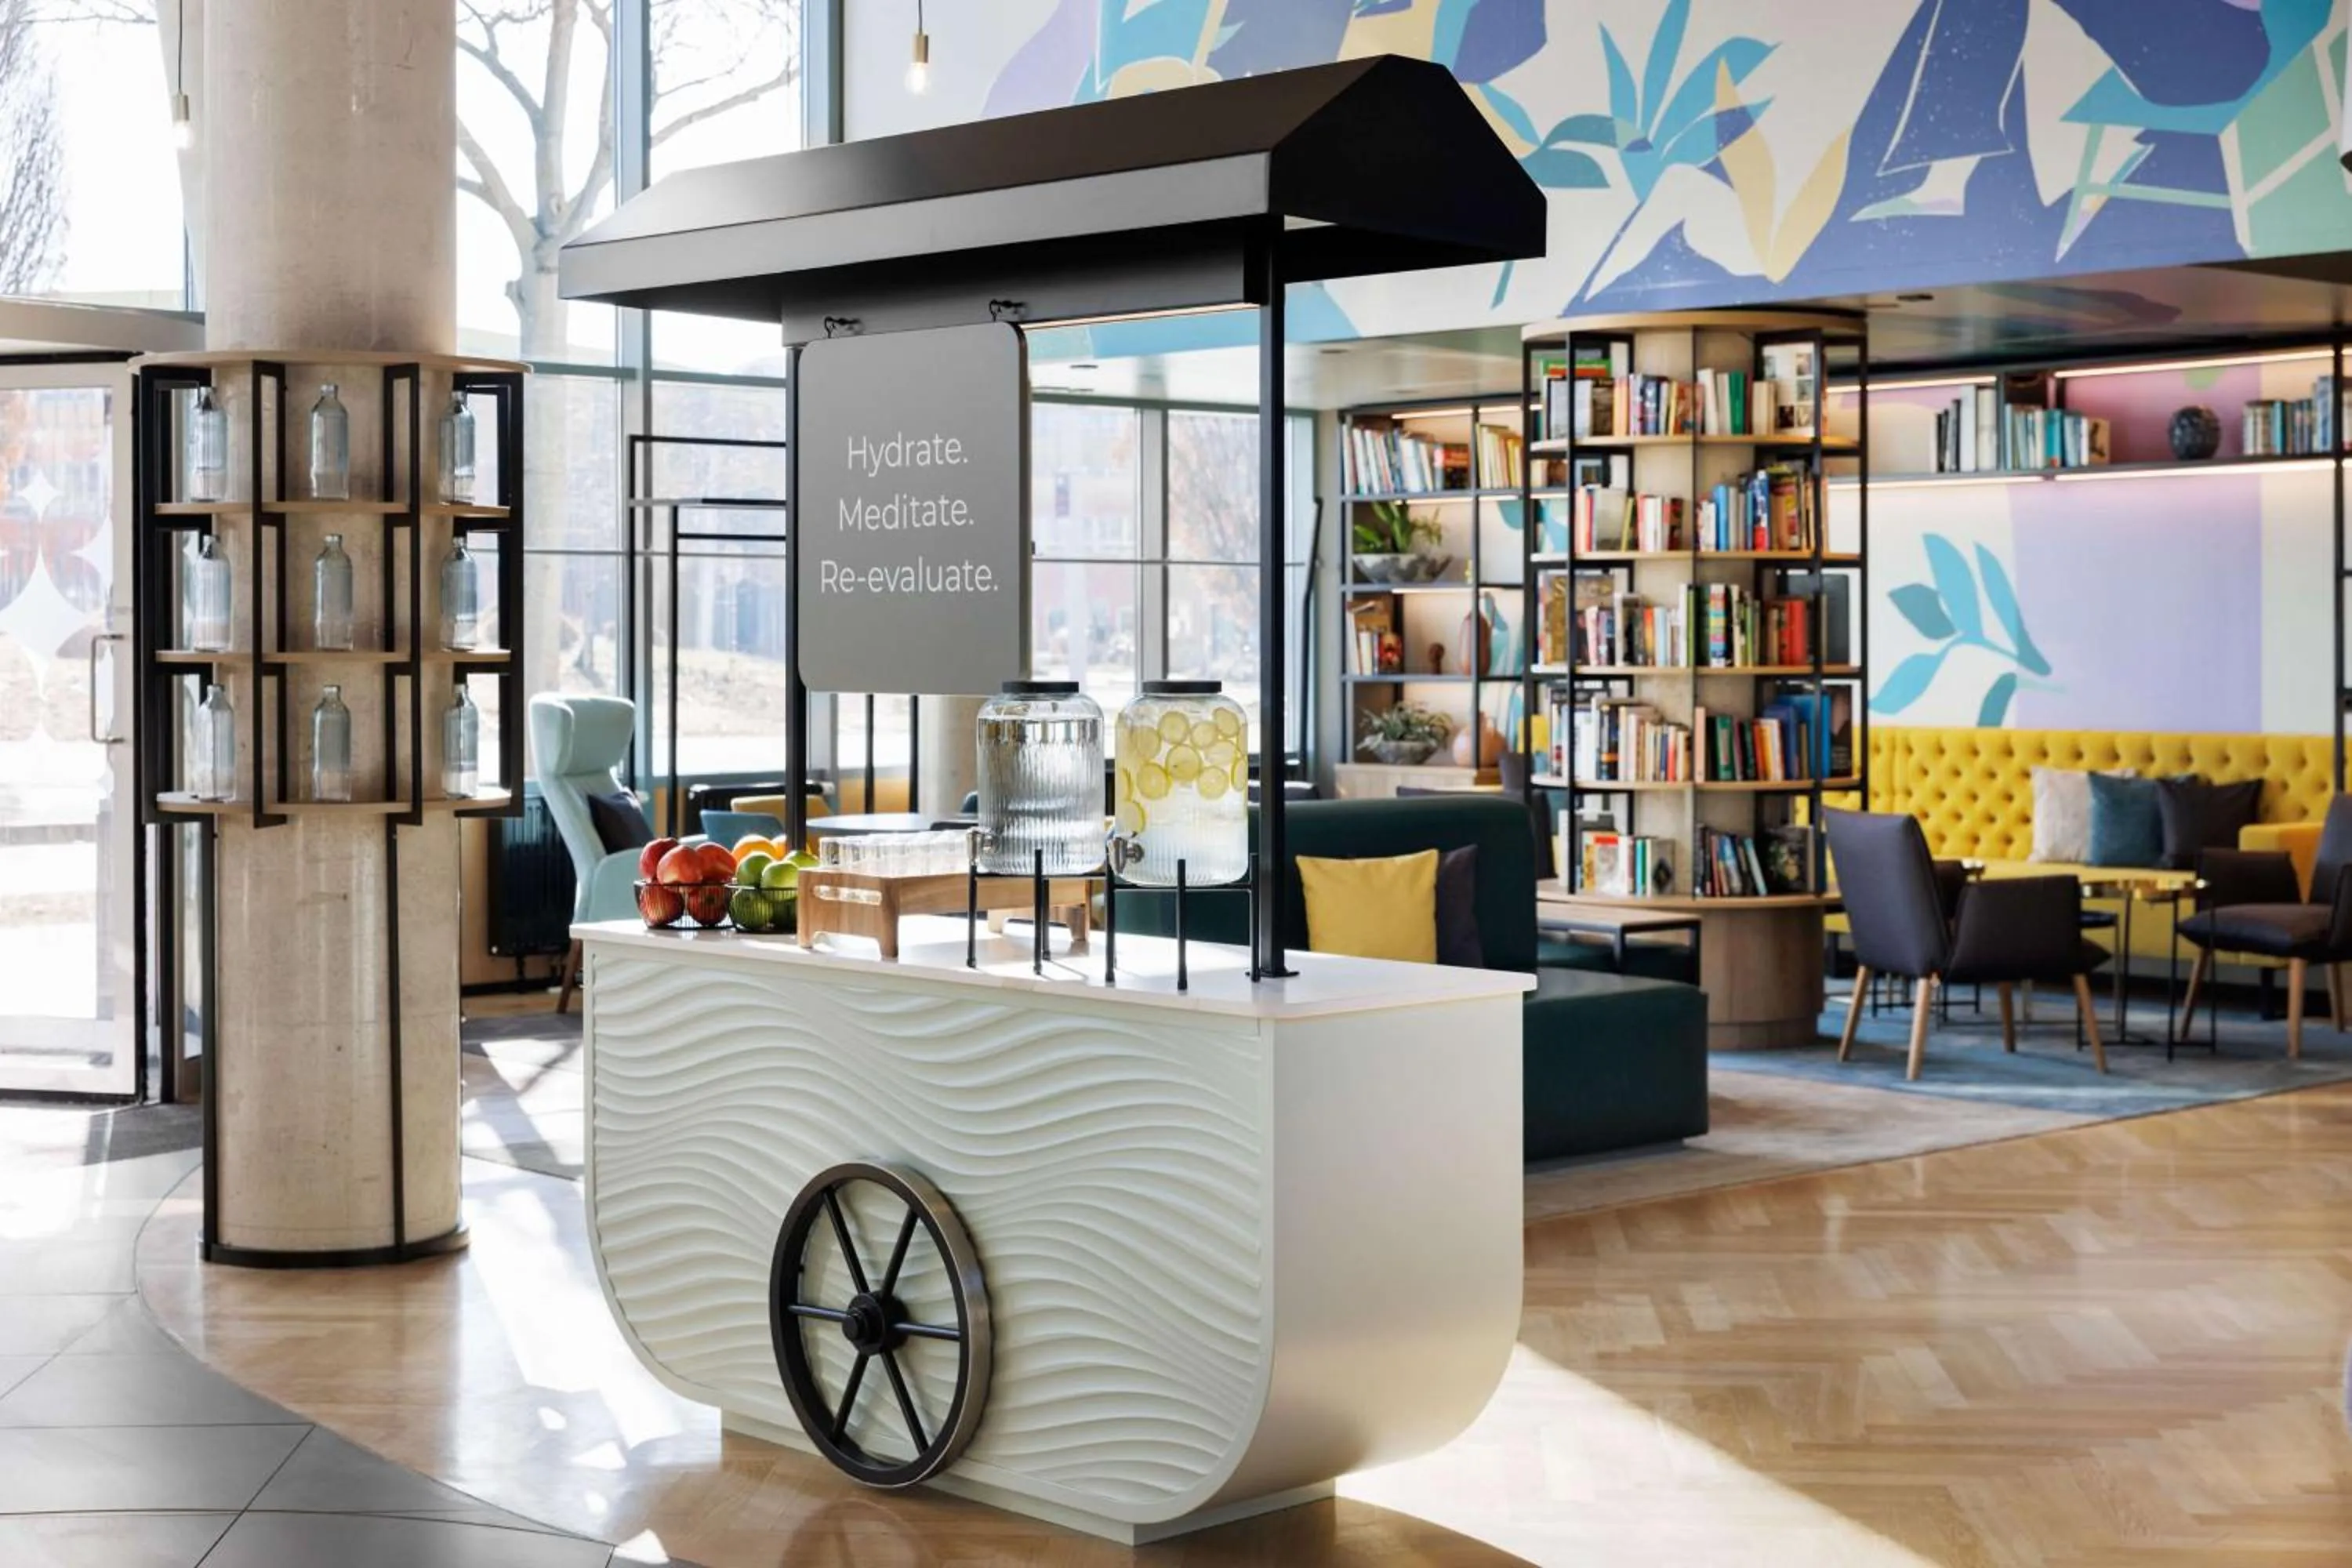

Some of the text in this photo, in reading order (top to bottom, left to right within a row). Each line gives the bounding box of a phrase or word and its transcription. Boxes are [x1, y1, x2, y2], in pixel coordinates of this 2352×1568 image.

[847, 431, 969, 477] Hydrate.
[839, 493, 975, 532] Meditate.
[820, 555, 999, 594] Re-evaluate.
